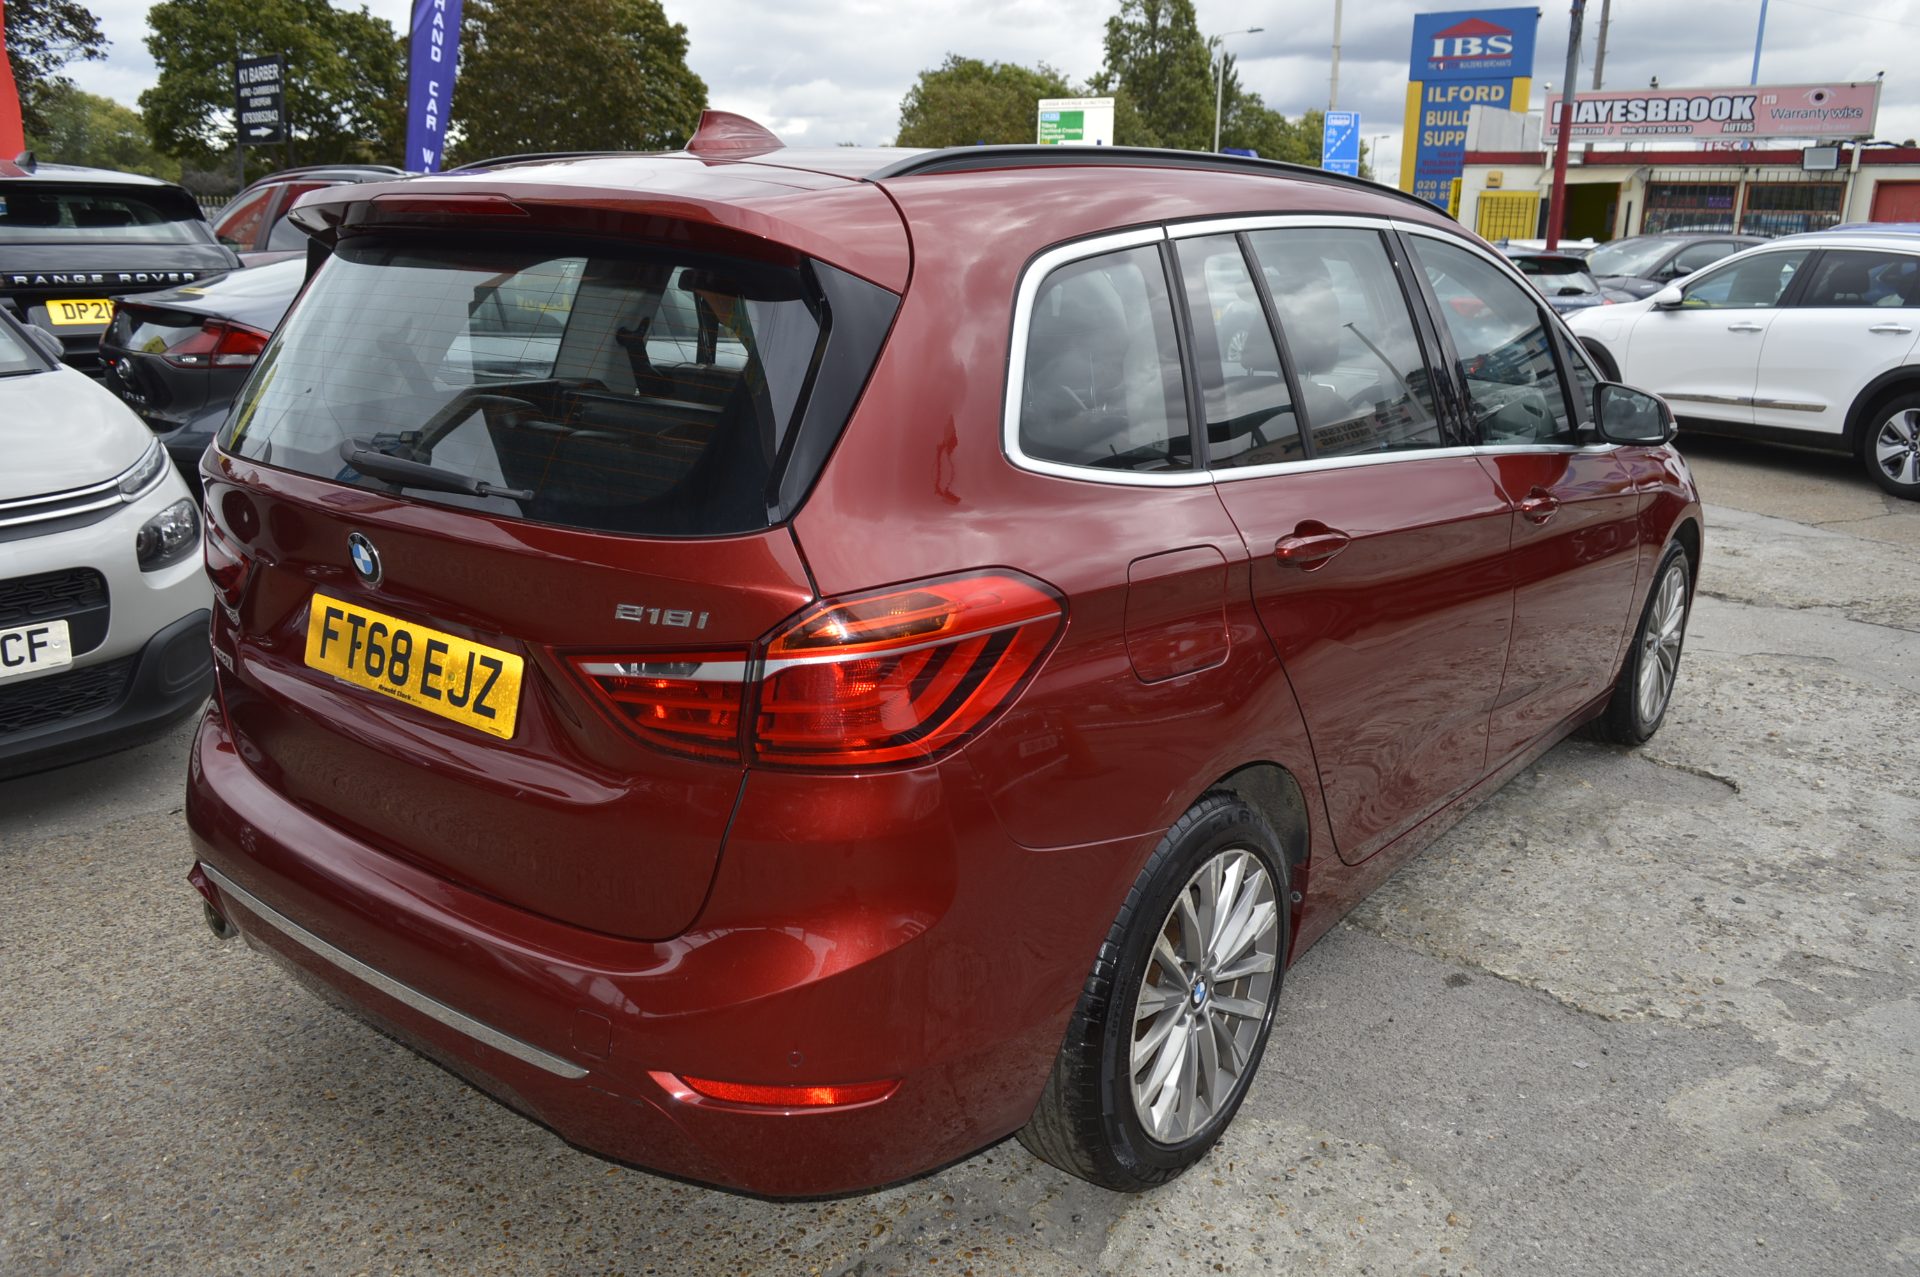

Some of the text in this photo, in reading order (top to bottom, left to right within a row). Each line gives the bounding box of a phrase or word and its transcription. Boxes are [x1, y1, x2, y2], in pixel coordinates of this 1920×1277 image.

[431, 0, 446, 63] HAND
[1432, 35, 1513, 58] IBS
[249, 64, 280, 83] BARBER
[1428, 86, 1505, 102] ILFORD
[1762, 95, 1777, 105] LTD
[426, 81, 439, 132] CAR
[1722, 122, 1755, 132] AUTOS
[1417, 181, 1437, 189] 020
[13, 273, 195, 285] RANGE ROVER
[615, 604, 709, 629] 218i
[0, 627, 49, 667] CF
[319, 606, 503, 719] FT68 EJZ
